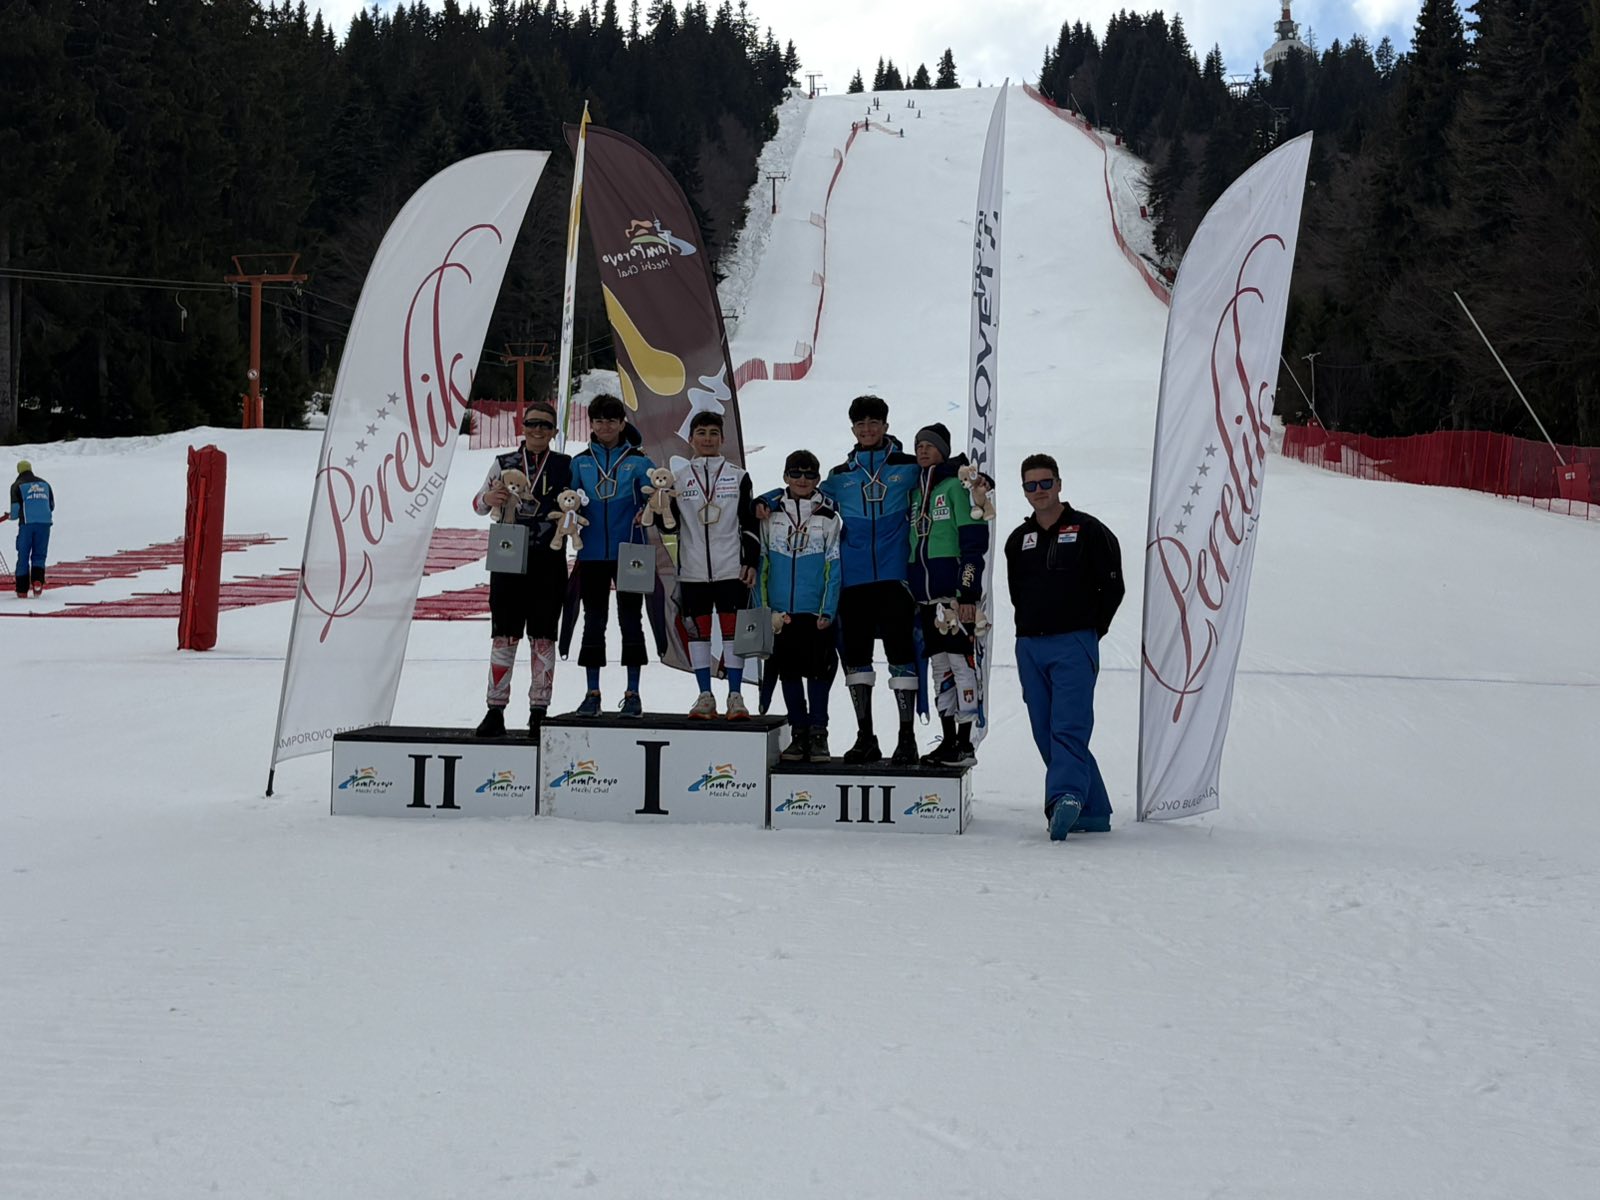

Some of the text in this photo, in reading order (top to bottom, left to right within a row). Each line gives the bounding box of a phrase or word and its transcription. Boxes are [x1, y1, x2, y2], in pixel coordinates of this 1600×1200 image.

[301, 224, 502, 643] Perelik
[405, 471, 448, 519] HOTEL
[407, 754, 462, 809] II
[635, 740, 670, 815] I
[835, 784, 896, 824] III
